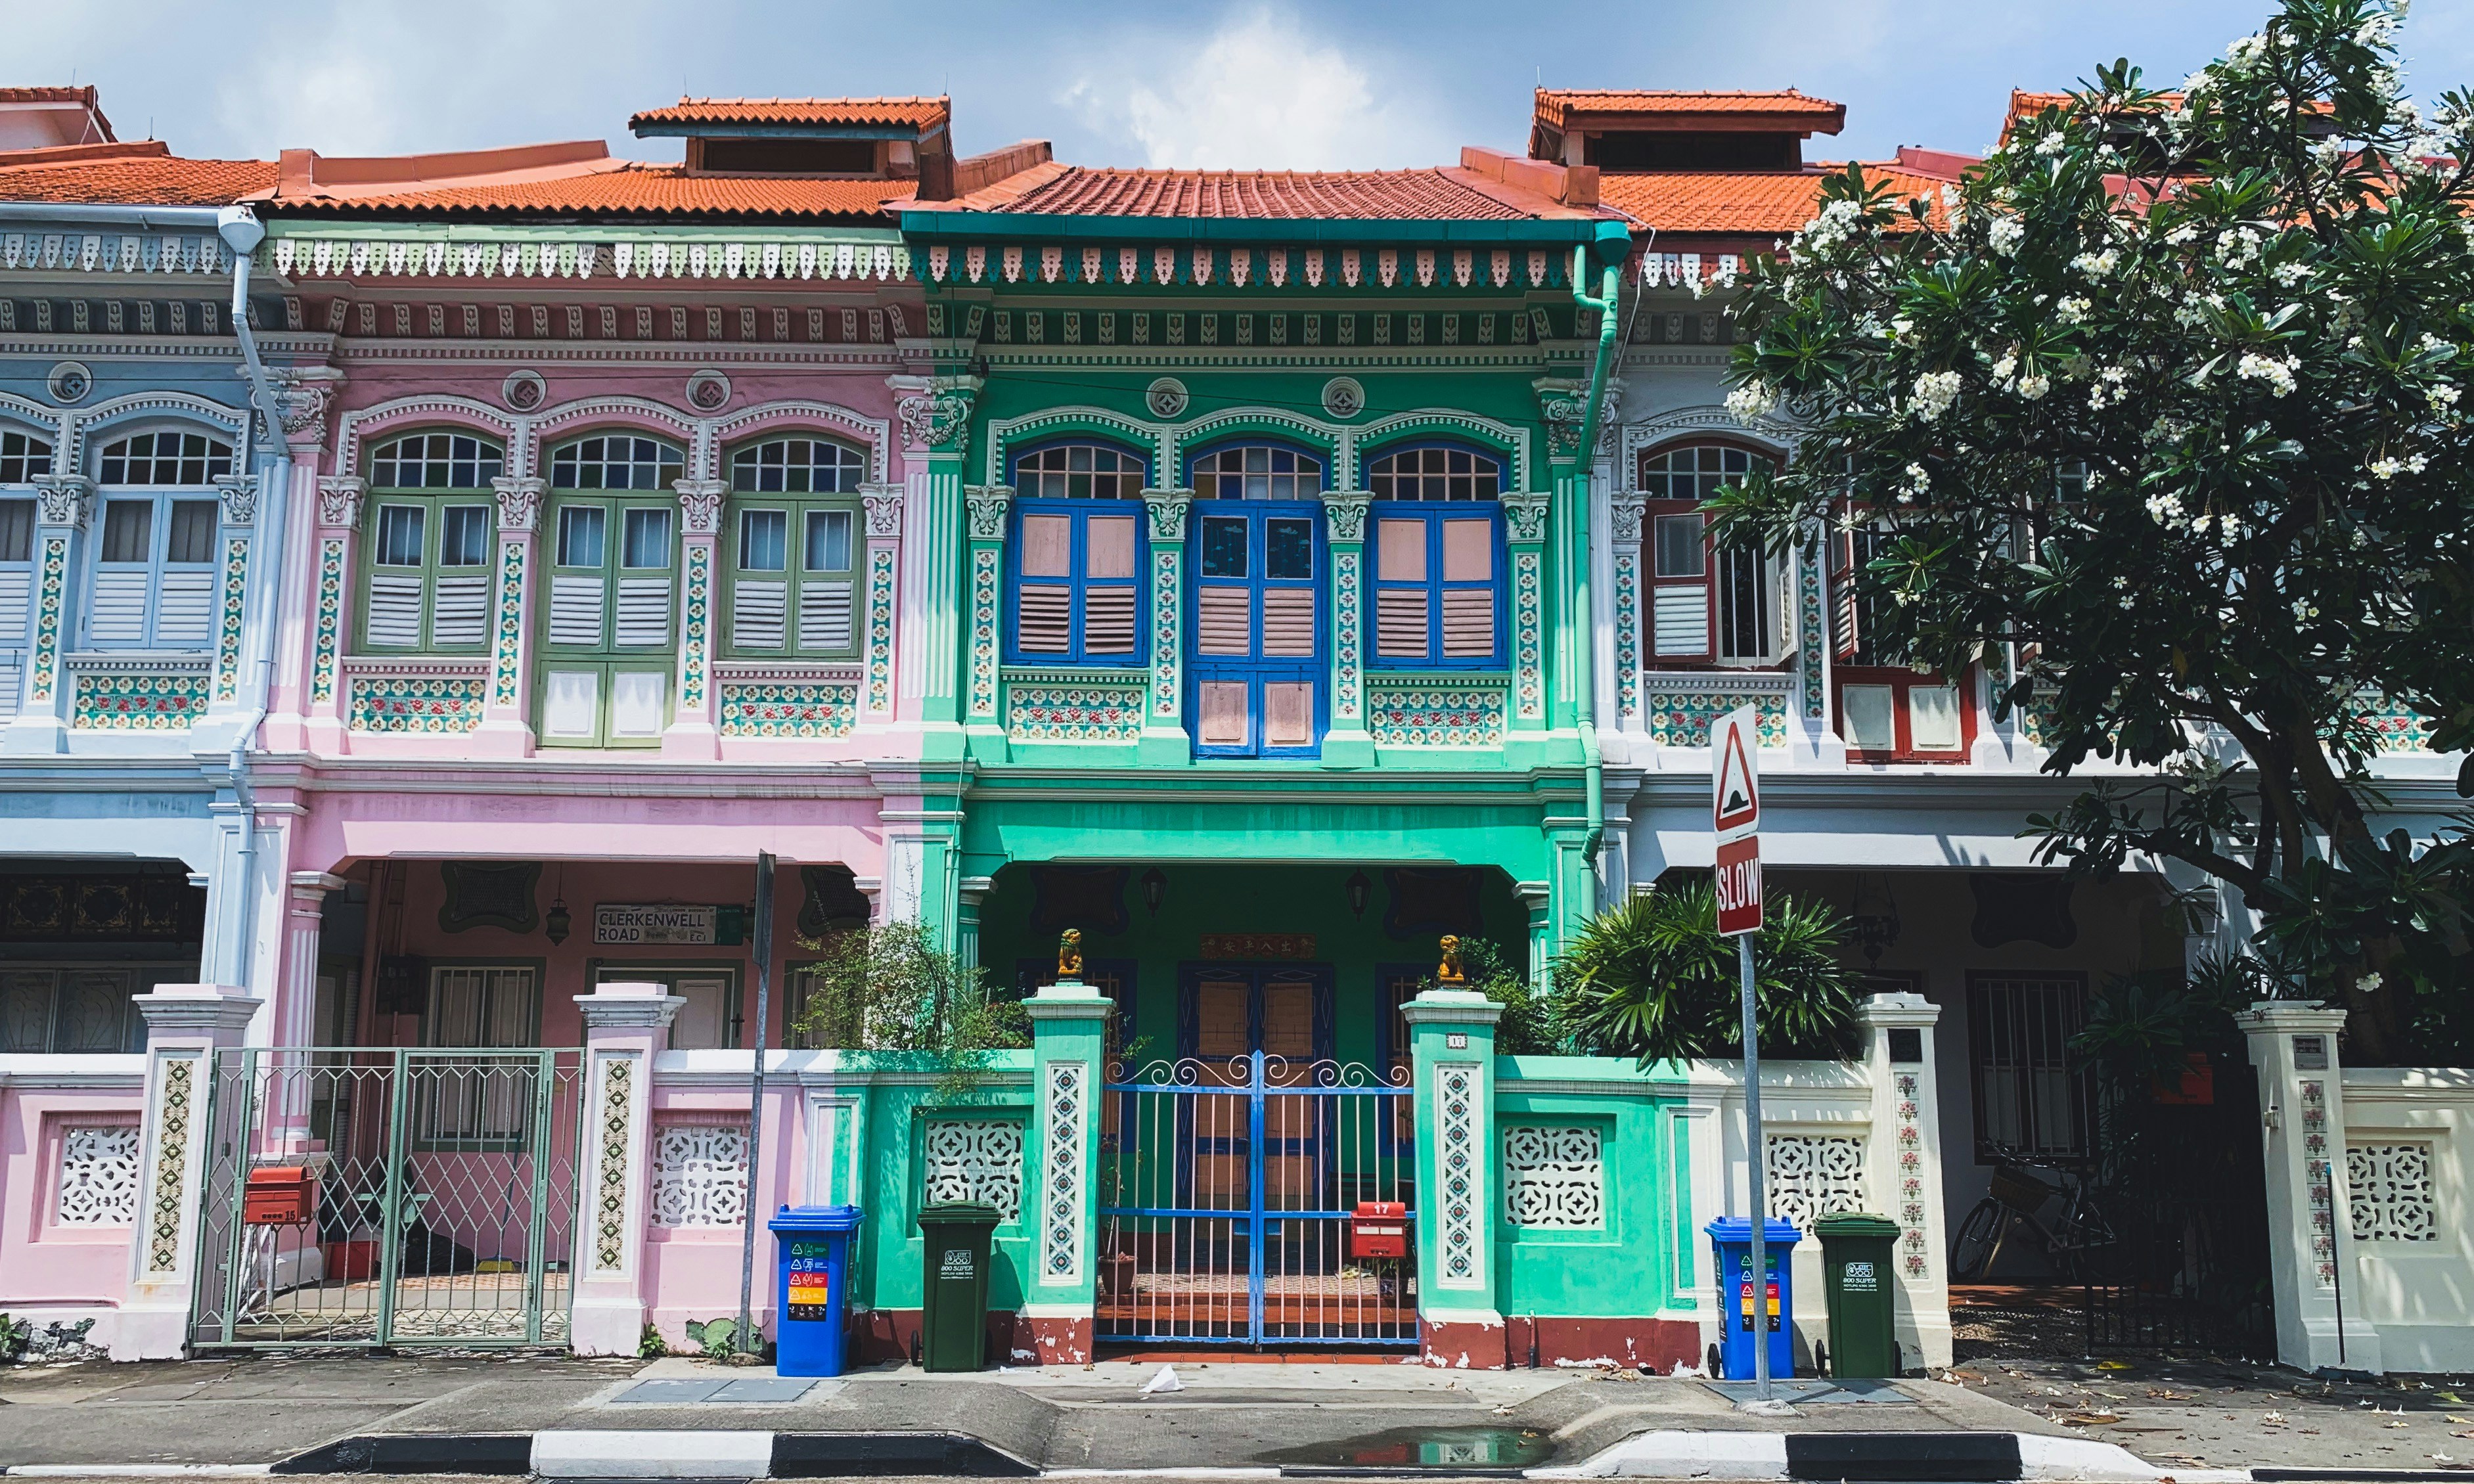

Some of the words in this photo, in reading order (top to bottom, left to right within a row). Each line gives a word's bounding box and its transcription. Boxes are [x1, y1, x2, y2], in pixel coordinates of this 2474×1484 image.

[1718, 857, 1759, 912] SLOW
[599, 912, 706, 927] CLERKENWELL
[598, 928, 640, 941] ROAD
[284, 1210, 296, 1221] 15
[1374, 1203, 1389, 1215] 17
